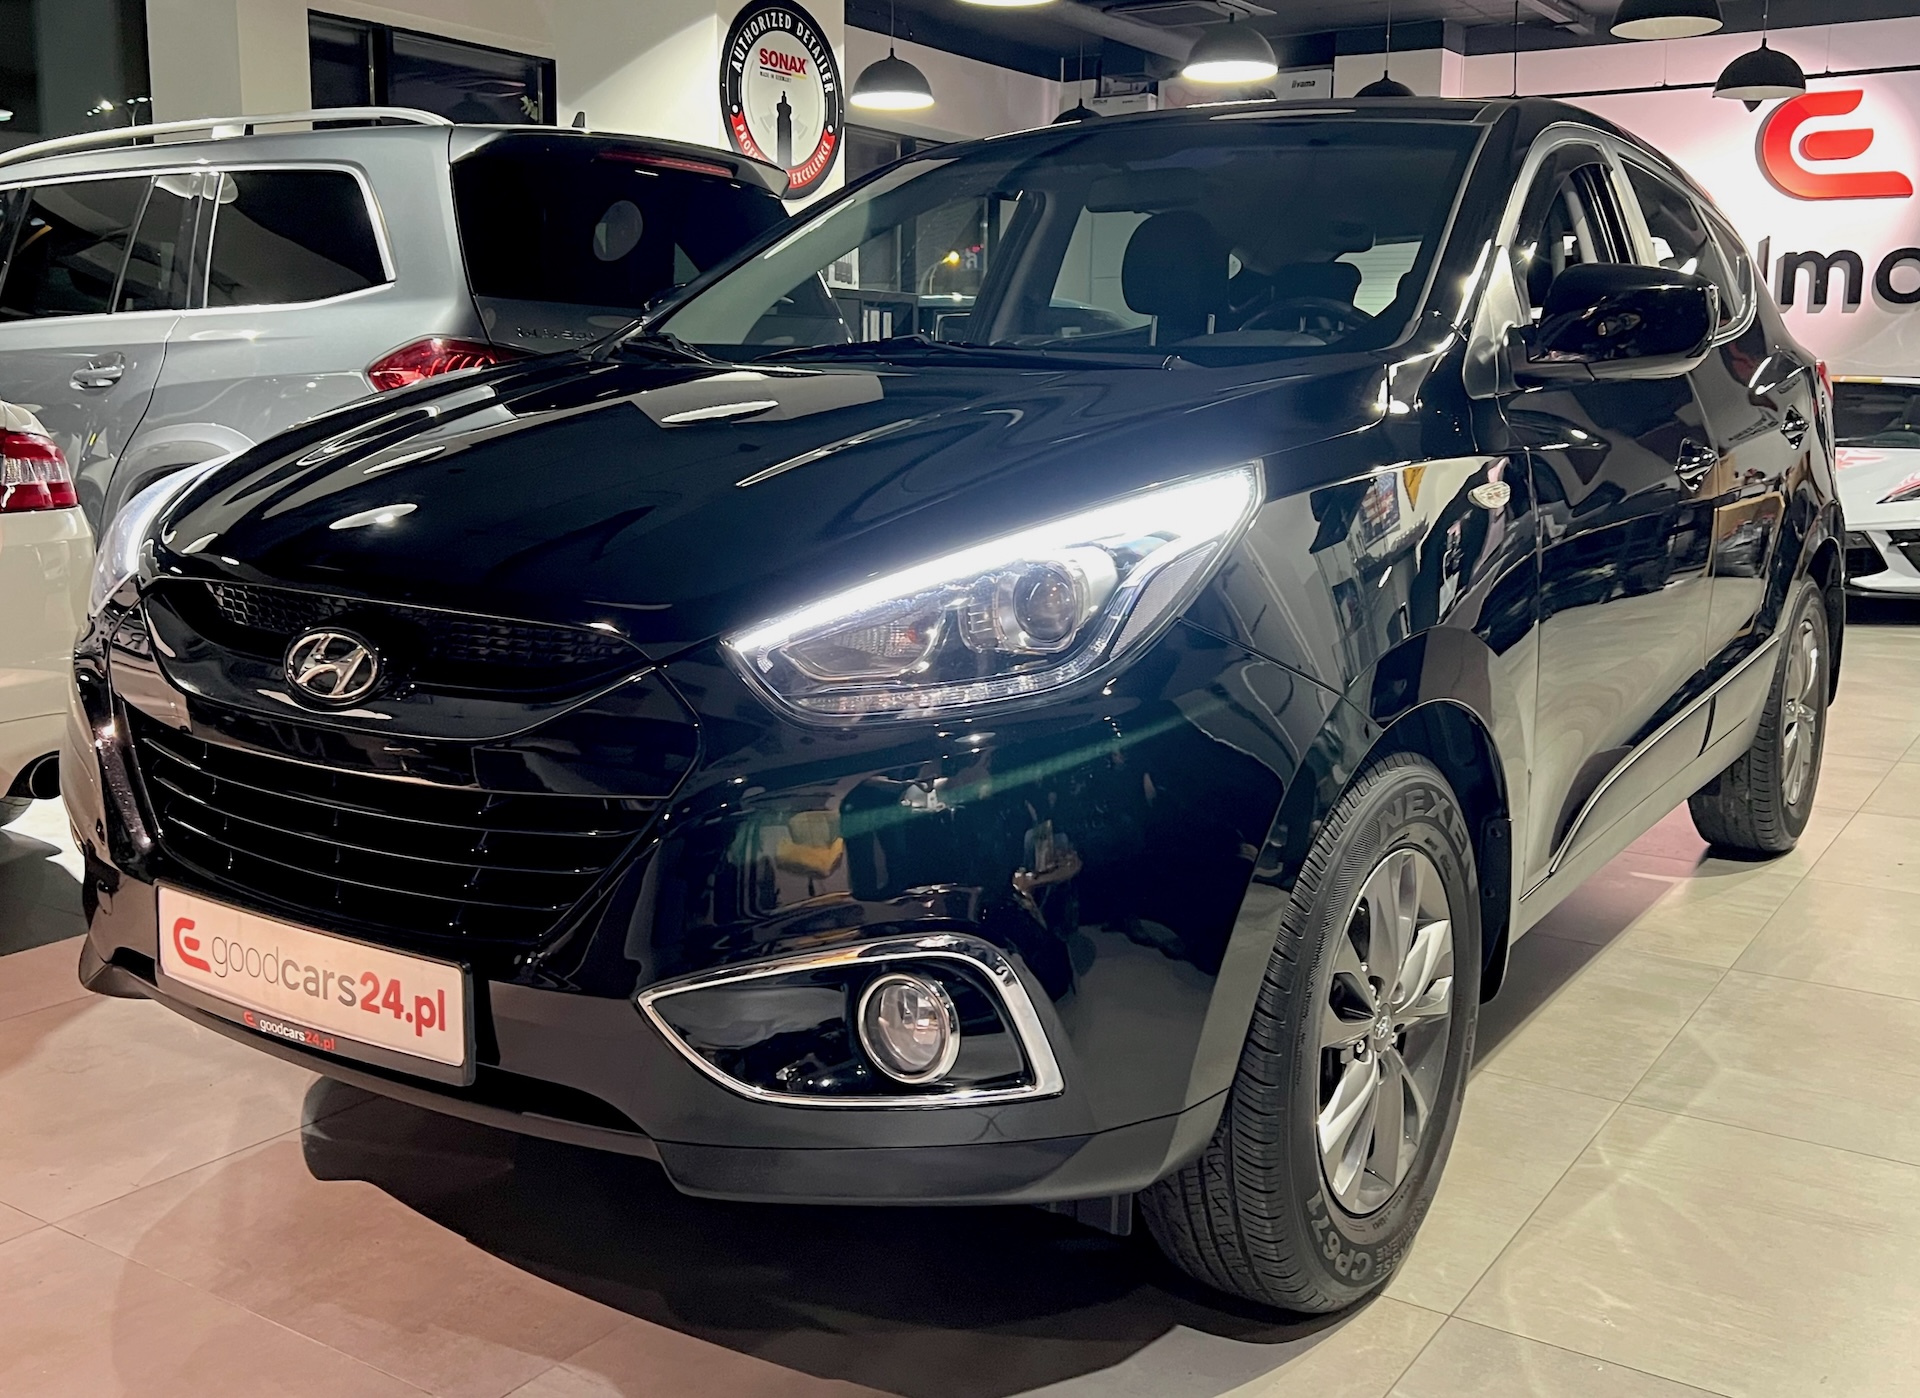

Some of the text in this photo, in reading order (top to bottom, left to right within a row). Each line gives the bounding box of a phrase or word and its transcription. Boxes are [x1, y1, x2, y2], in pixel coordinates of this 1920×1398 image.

[731, 12, 834, 93] AUTHORIZED DETAILER
[759, 48, 807, 75] SONAX
[792, 141, 831, 184] EXCELLENCE
[1379, 788, 1479, 894] NEXEN
[211, 936, 446, 1037] goodcars24.pl
[260, 1019, 336, 1051] goodcars24.pl
